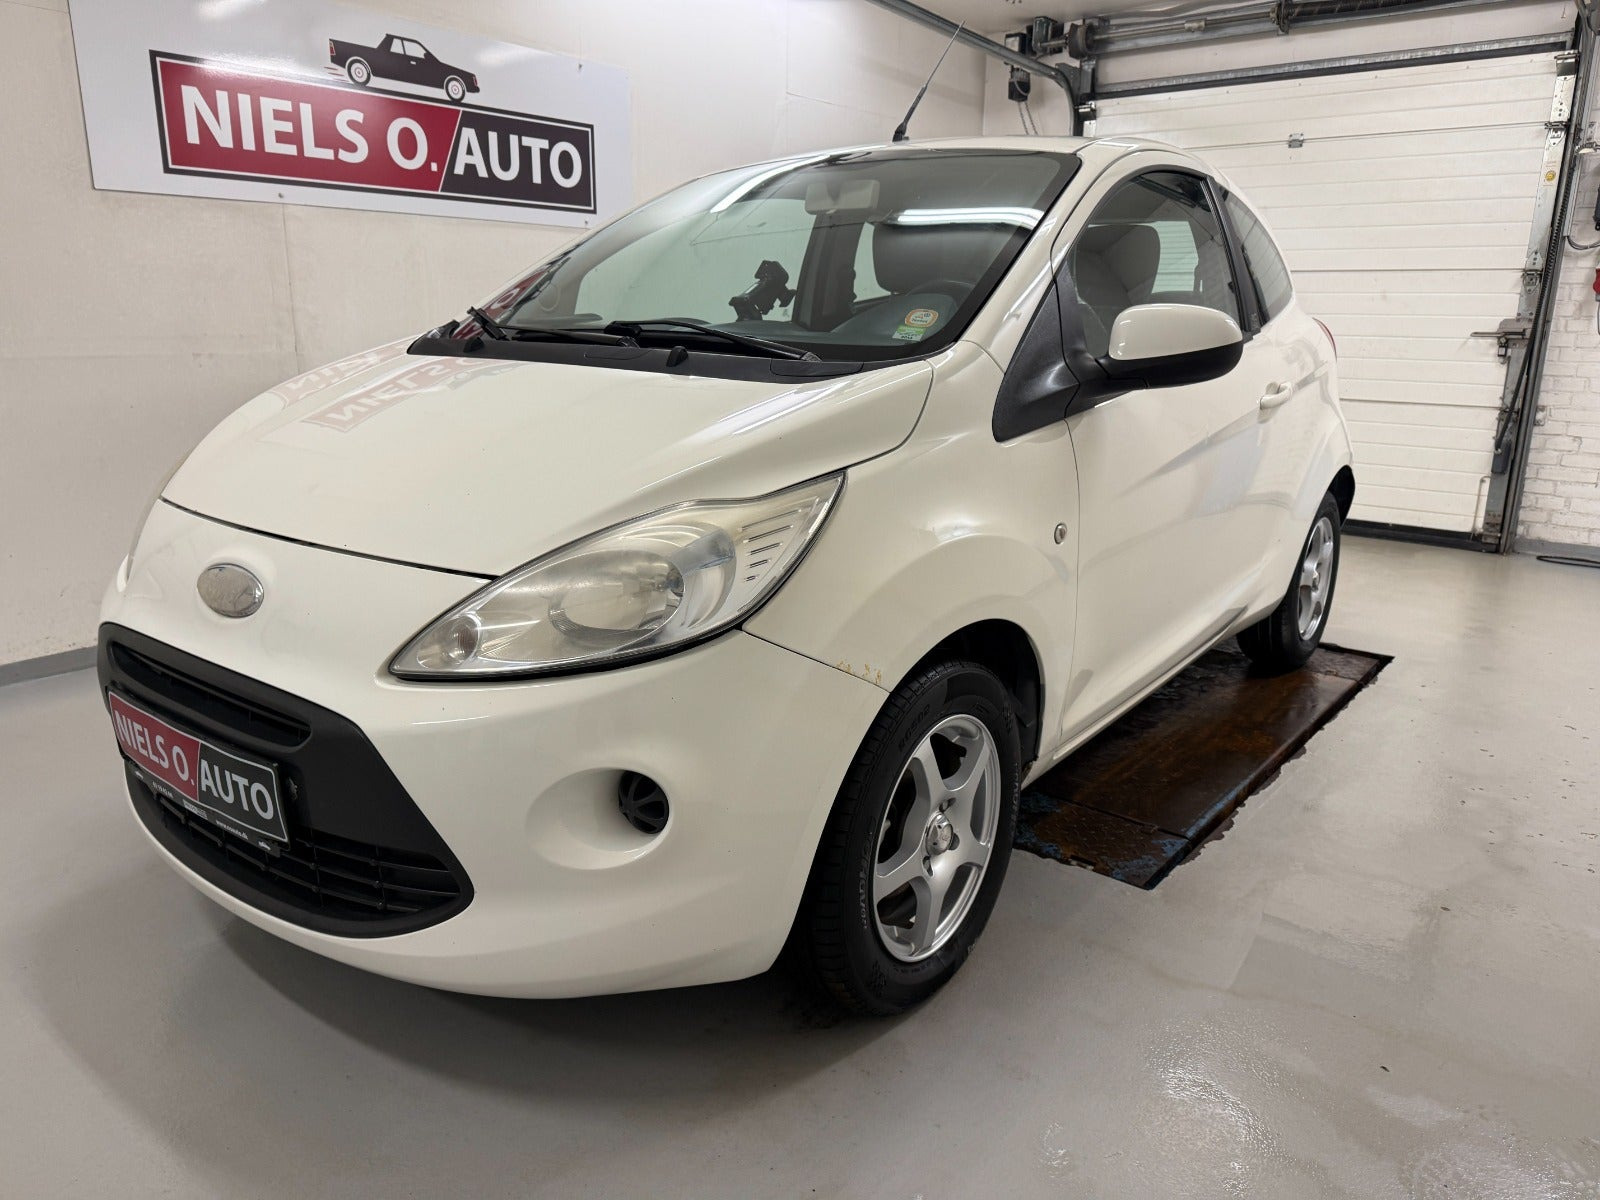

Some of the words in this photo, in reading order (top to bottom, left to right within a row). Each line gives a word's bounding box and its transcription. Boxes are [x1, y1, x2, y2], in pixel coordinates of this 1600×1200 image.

[180, 84, 369, 164] NIELS
[386, 117, 438, 172] O.
[453, 127, 582, 189] AUTO
[114, 710, 169, 769] NIELS
[172, 745, 195, 786] O.
[200, 759, 274, 820] AUTO
